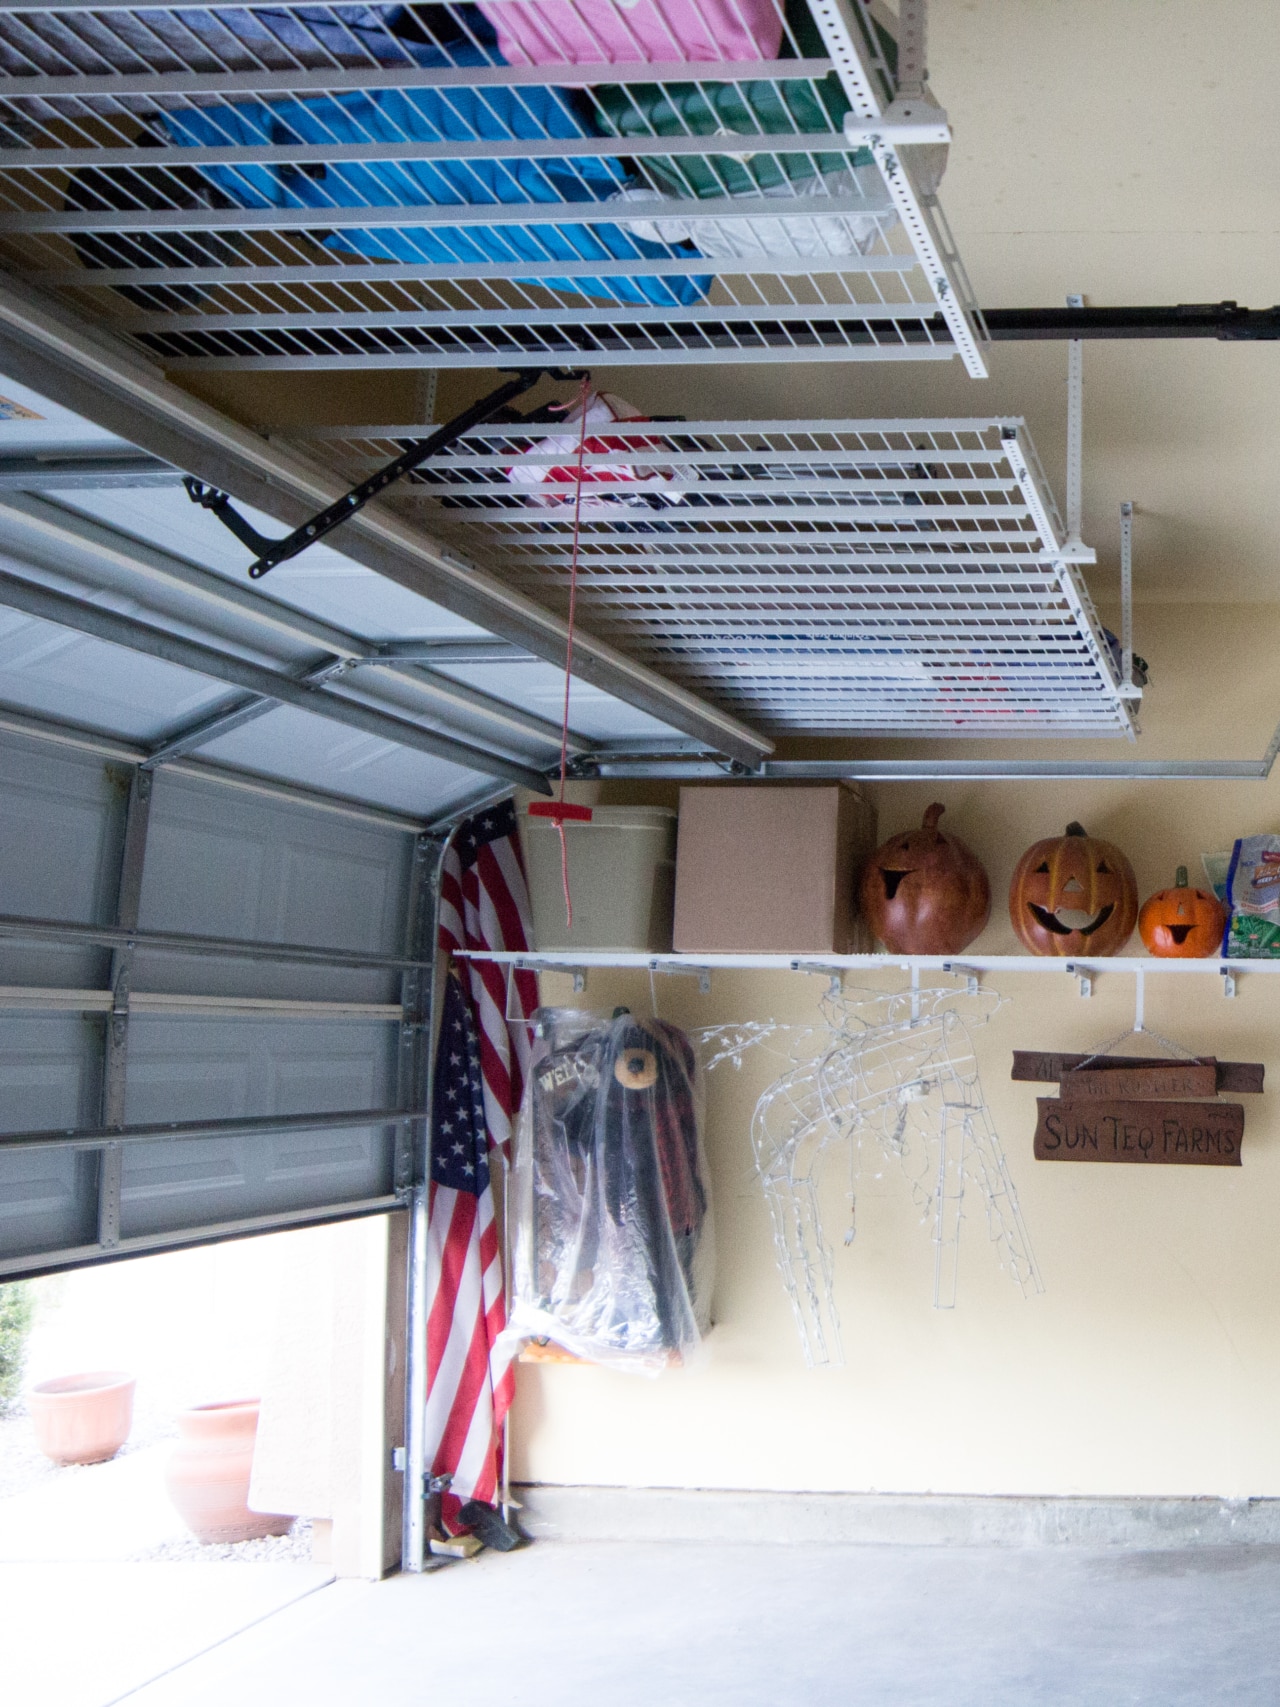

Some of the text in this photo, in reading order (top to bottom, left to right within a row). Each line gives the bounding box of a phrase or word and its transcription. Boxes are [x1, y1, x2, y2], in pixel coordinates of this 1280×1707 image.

[1044, 1114, 1235, 1158] SUN TEQ FARMS
